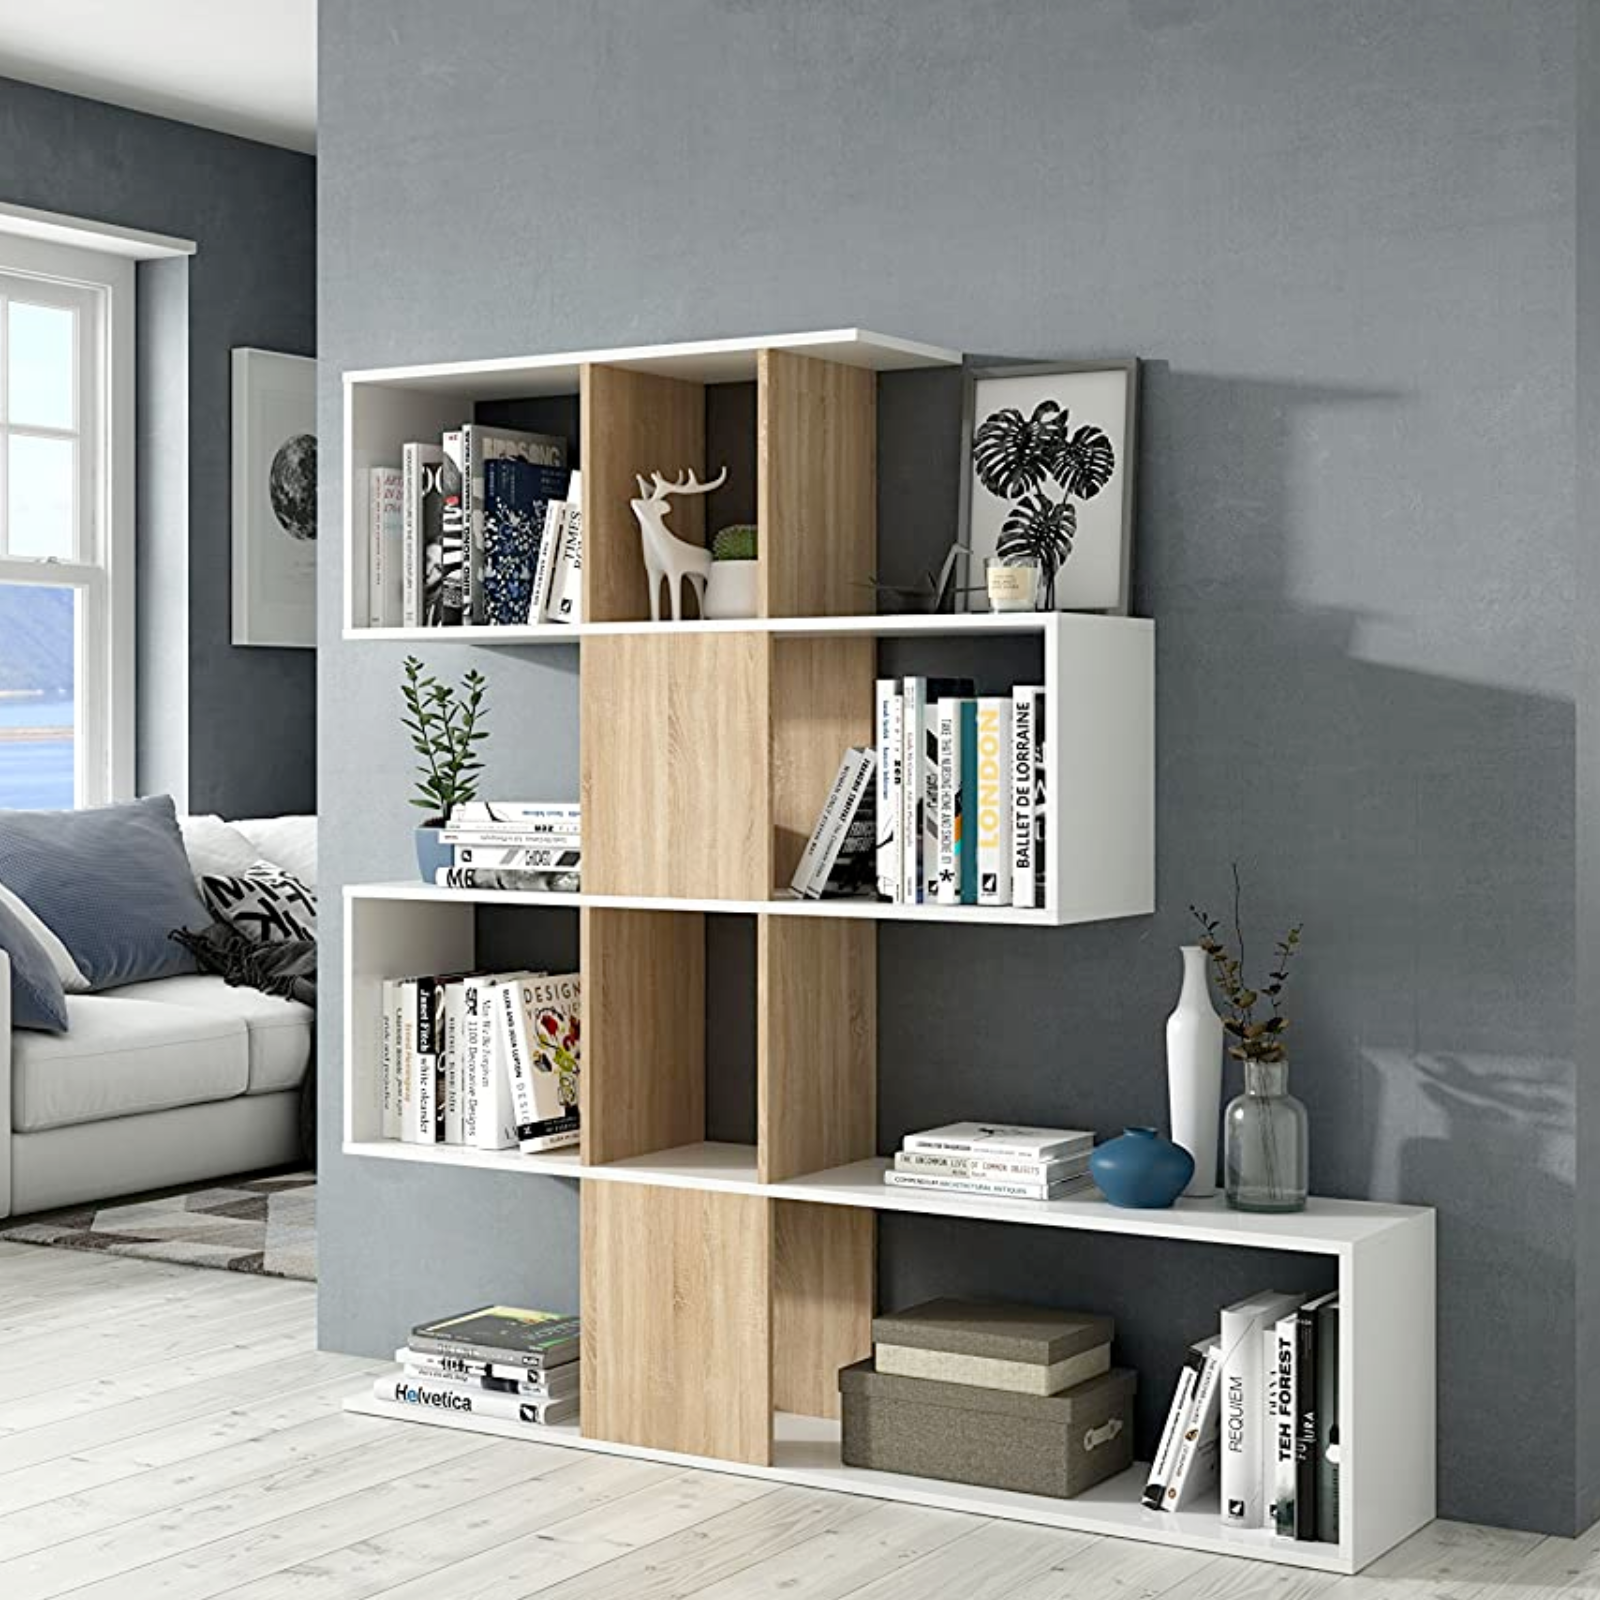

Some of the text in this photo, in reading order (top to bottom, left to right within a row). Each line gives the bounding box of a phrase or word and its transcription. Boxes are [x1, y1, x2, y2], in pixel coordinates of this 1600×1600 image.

[563, 510, 580, 561] TIMES
[894, 759, 902, 786] zen
[980, 709, 1000, 848] LONDON
[1016, 701, 1031, 868] BALLET DE LORRAINE
[523, 981, 581, 1004] DESIGN
[467, 1021, 478, 1044] 1100
[420, 988, 430, 1133] Janet Fitch white oleander
[467, 1047, 478, 1097] Decorative
[465, 1099, 478, 1136] Designs
[395, 1383, 473, 1411] Helvetica
[1229, 1376, 1244, 1453] REQUIEM
[1279, 1337, 1292, 1463] TEH FOREST
